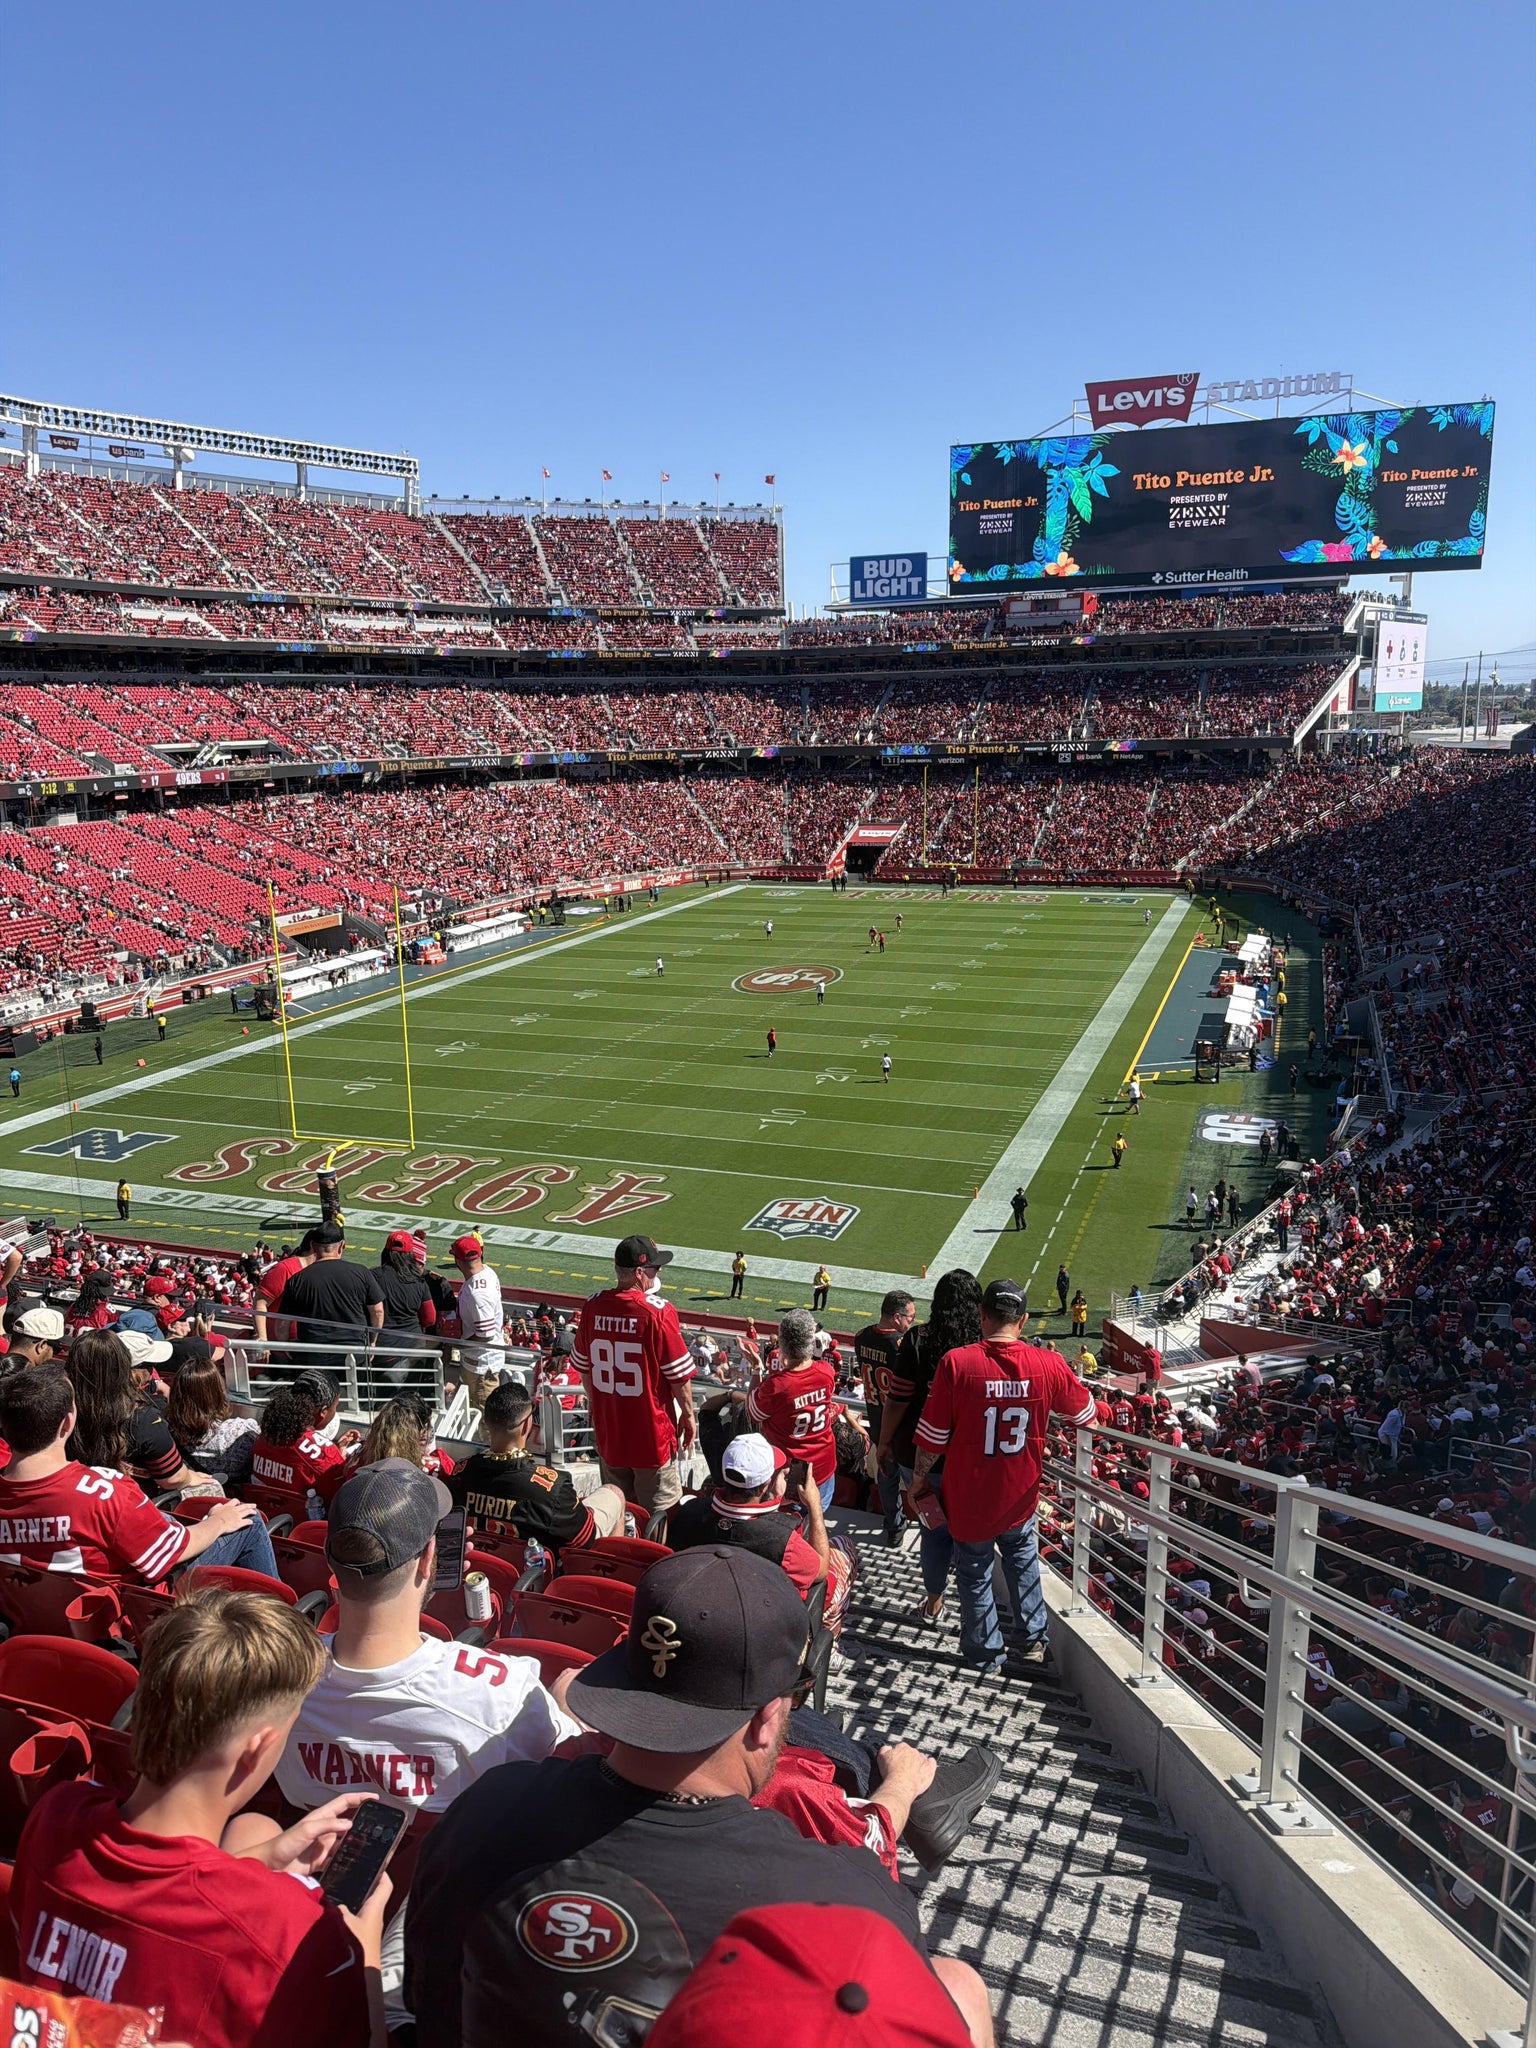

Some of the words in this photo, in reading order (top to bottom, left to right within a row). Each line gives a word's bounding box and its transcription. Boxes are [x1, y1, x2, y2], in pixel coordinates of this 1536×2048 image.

[1207, 371, 1341, 404] STADIUM
[124, 448, 145, 458] bank
[1133, 473, 1171, 490] Tito
[1175, 469, 1245, 487] Puente
[1249, 466, 1275, 483] Jr.
[1381, 470, 1408, 483] Tito
[1411, 468, 1459, 480] Puente
[1461, 466, 1479, 477] Jr.
[1406, 484, 1439, 492] PRESENTED
[958, 501, 980, 512] Tito
[983, 498, 1022, 510] Puente
[1024, 496, 1039, 507] Jr.
[1170, 494, 1216, 504] PRESENTED
[1218, 493, 1228, 501] BY
[1405, 500, 1445, 508] EYEWEAR
[1169, 518, 1226, 528] EYEWEAR
[863, 558, 912, 579] BUD
[1165, 571, 1205, 583] Sutter
[1207, 568, 1249, 581] Health
[854, 577, 922, 598] LIGHT
[606, 752, 626, 761] Tito
[628, 751, 663, 761] Puente
[665, 751, 678, 760] Jr.
[946, 745, 966, 755] Tito
[968, 744, 999, 754] Puente
[1003, 743, 1020, 753] Jr.
[379, 762, 398, 772] Tito
[400, 760, 433, 771] Puente
[435, 760, 447, 769] Jr.
[151, 776, 159, 786] 17
[176, 772, 201, 785] 49ERS
[41, 783, 57, 794] 7:12
[815, 1067, 857, 1084] 20
[760, 1108, 807, 1127] 10
[162, 1137, 675, 1226] 49ERS
[150, 1191, 204, 1204] US
[776, 1201, 849, 1224] NFL
[365, 1214, 500, 1240] TAKES
[514, 1232, 564, 1247] IT
[473, 1278, 487, 1289] 19
[594, 1314, 638, 1334] KITTLE
[860, 1345, 887, 1364] FAITHFUL
[1123, 1352, 1144, 1370] pwc
[590, 1338, 643, 1397] 85
[985, 1380, 1030, 1398] PURDY
[794, 1388, 827, 1410] KITTLE
[792, 1404, 827, 1438] 85
[984, 1406, 1030, 1456] 13
[299, 1433, 333, 1460] 54
[75, 1466, 124, 1500] 54
[530, 1465, 559, 1492] 13
[466, 1492, 516, 1520] PURDY
[454, 1648, 508, 1687] 5
[298, 1742, 435, 1797] WARNER
[1477, 1809, 1497, 1826] RICE
[545, 1901, 611, 1960] SF
[26, 1910, 127, 2004] LENOIR
